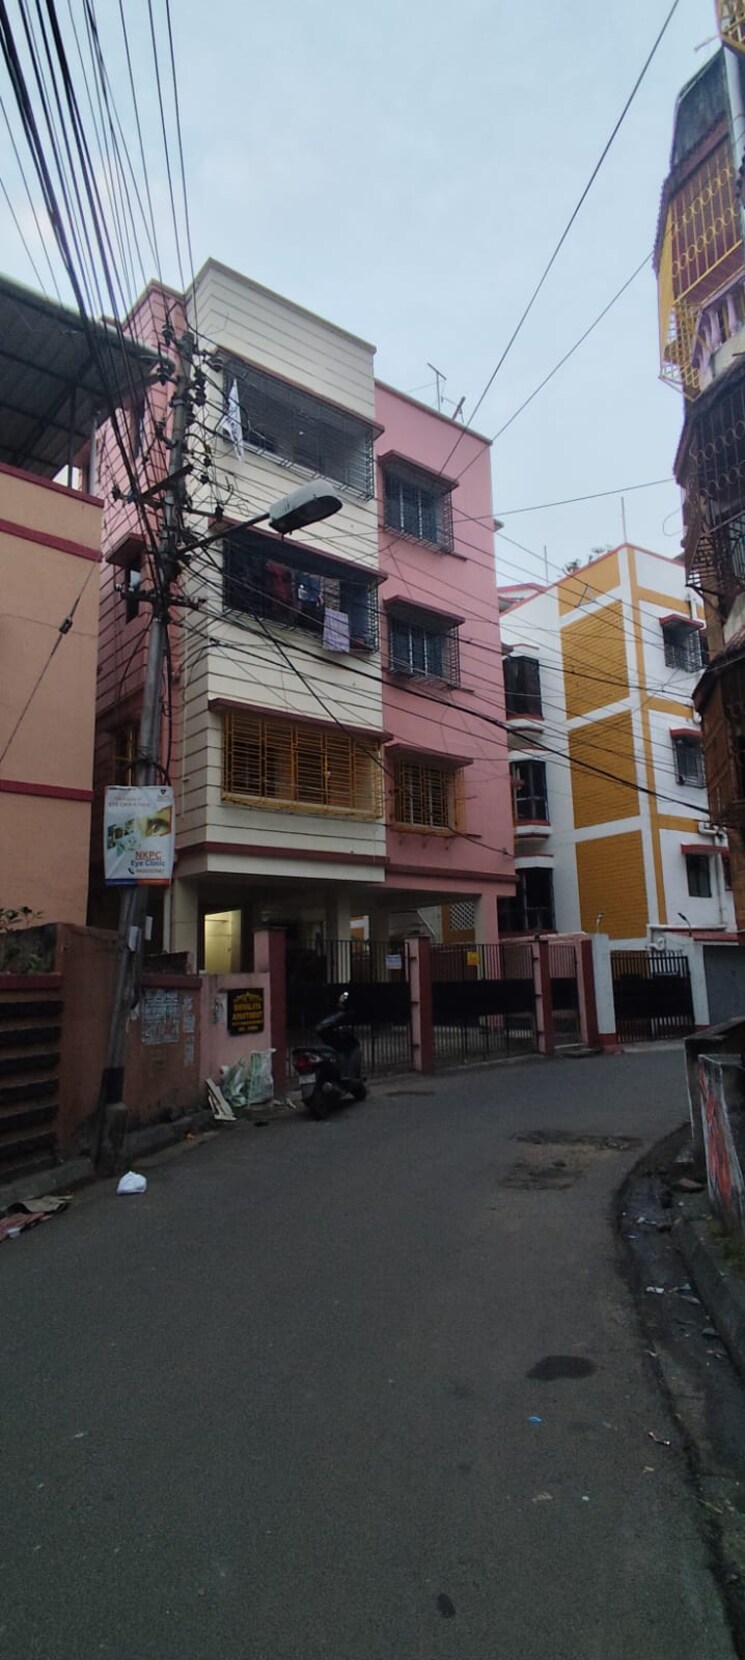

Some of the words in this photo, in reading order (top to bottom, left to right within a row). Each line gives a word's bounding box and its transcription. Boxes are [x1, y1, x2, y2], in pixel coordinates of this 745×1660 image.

[135, 851, 161, 860] NKPC
[131, 859, 144, 868] Eye
[145, 859, 166, 867] Clinic
